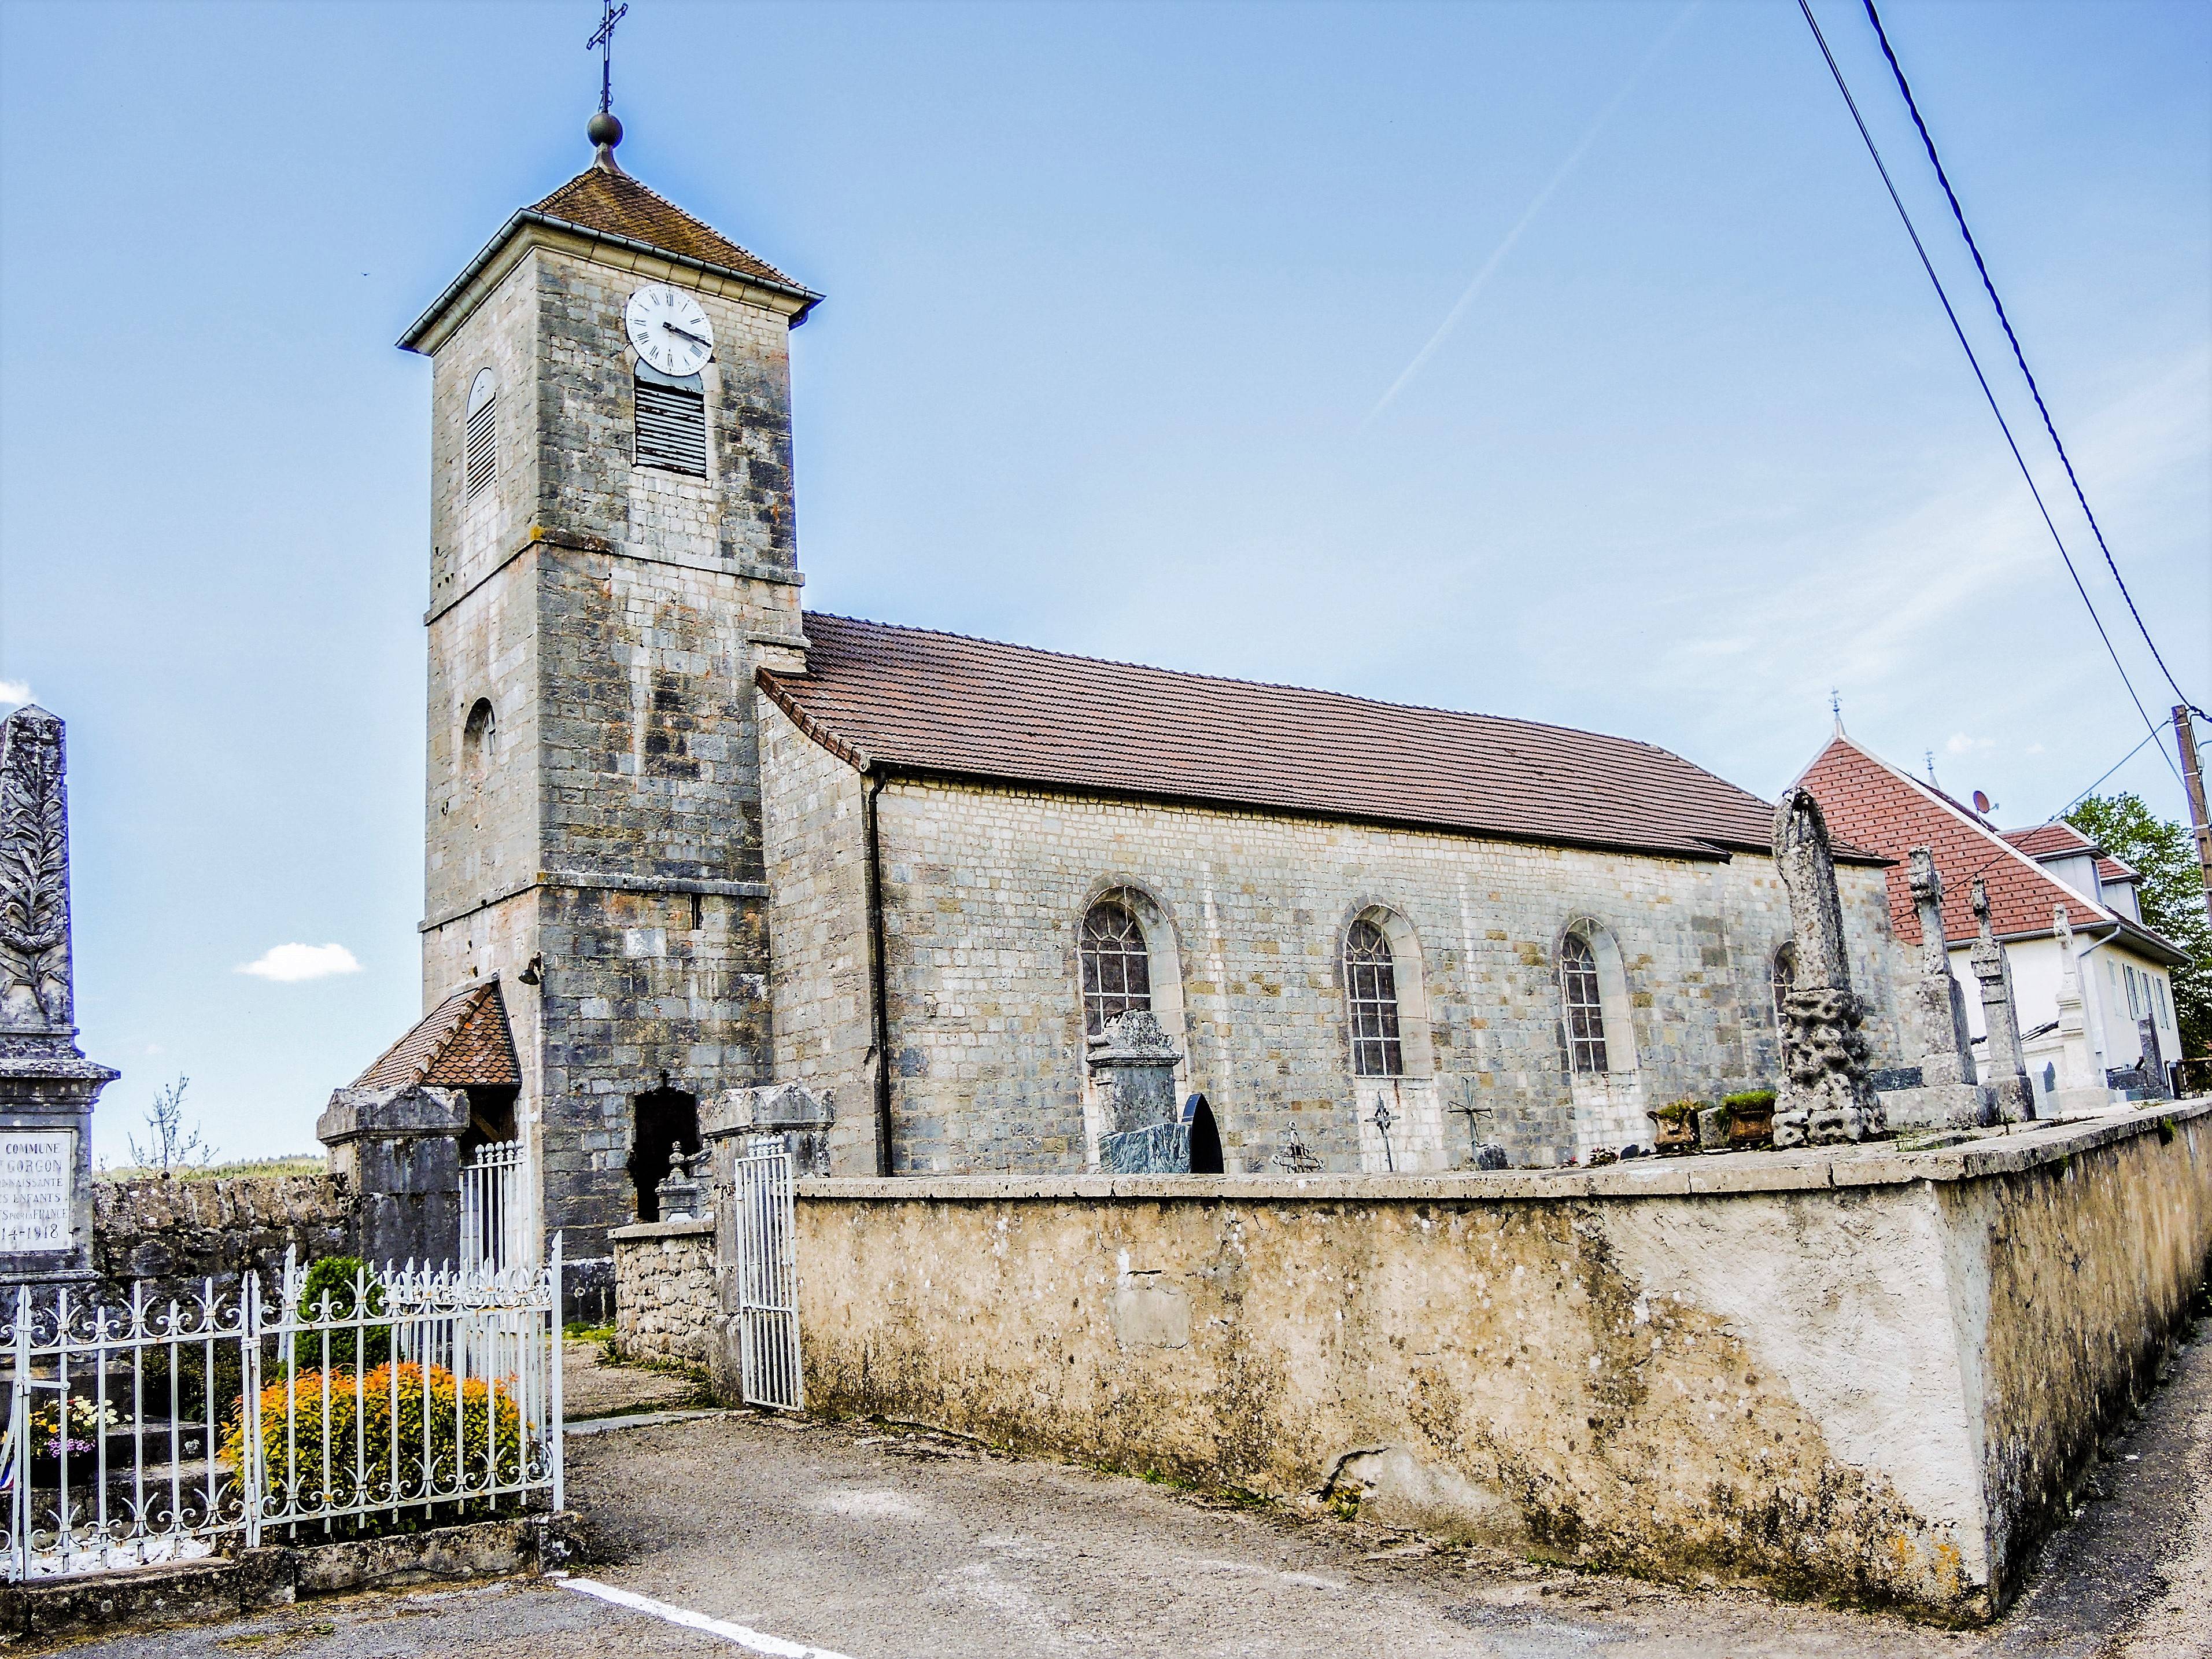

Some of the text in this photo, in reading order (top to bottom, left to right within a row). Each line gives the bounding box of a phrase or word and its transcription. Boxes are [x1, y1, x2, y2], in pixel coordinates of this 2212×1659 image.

[6, 1143, 60, 1155] COMMUNE
[8, 1160, 61, 1173] GORGON
[0, 1178, 63, 1188] NNAISSANTE
[13, 1193, 60, 1203] ENFANTS
[33, 1208, 68, 1219] FRANCE
